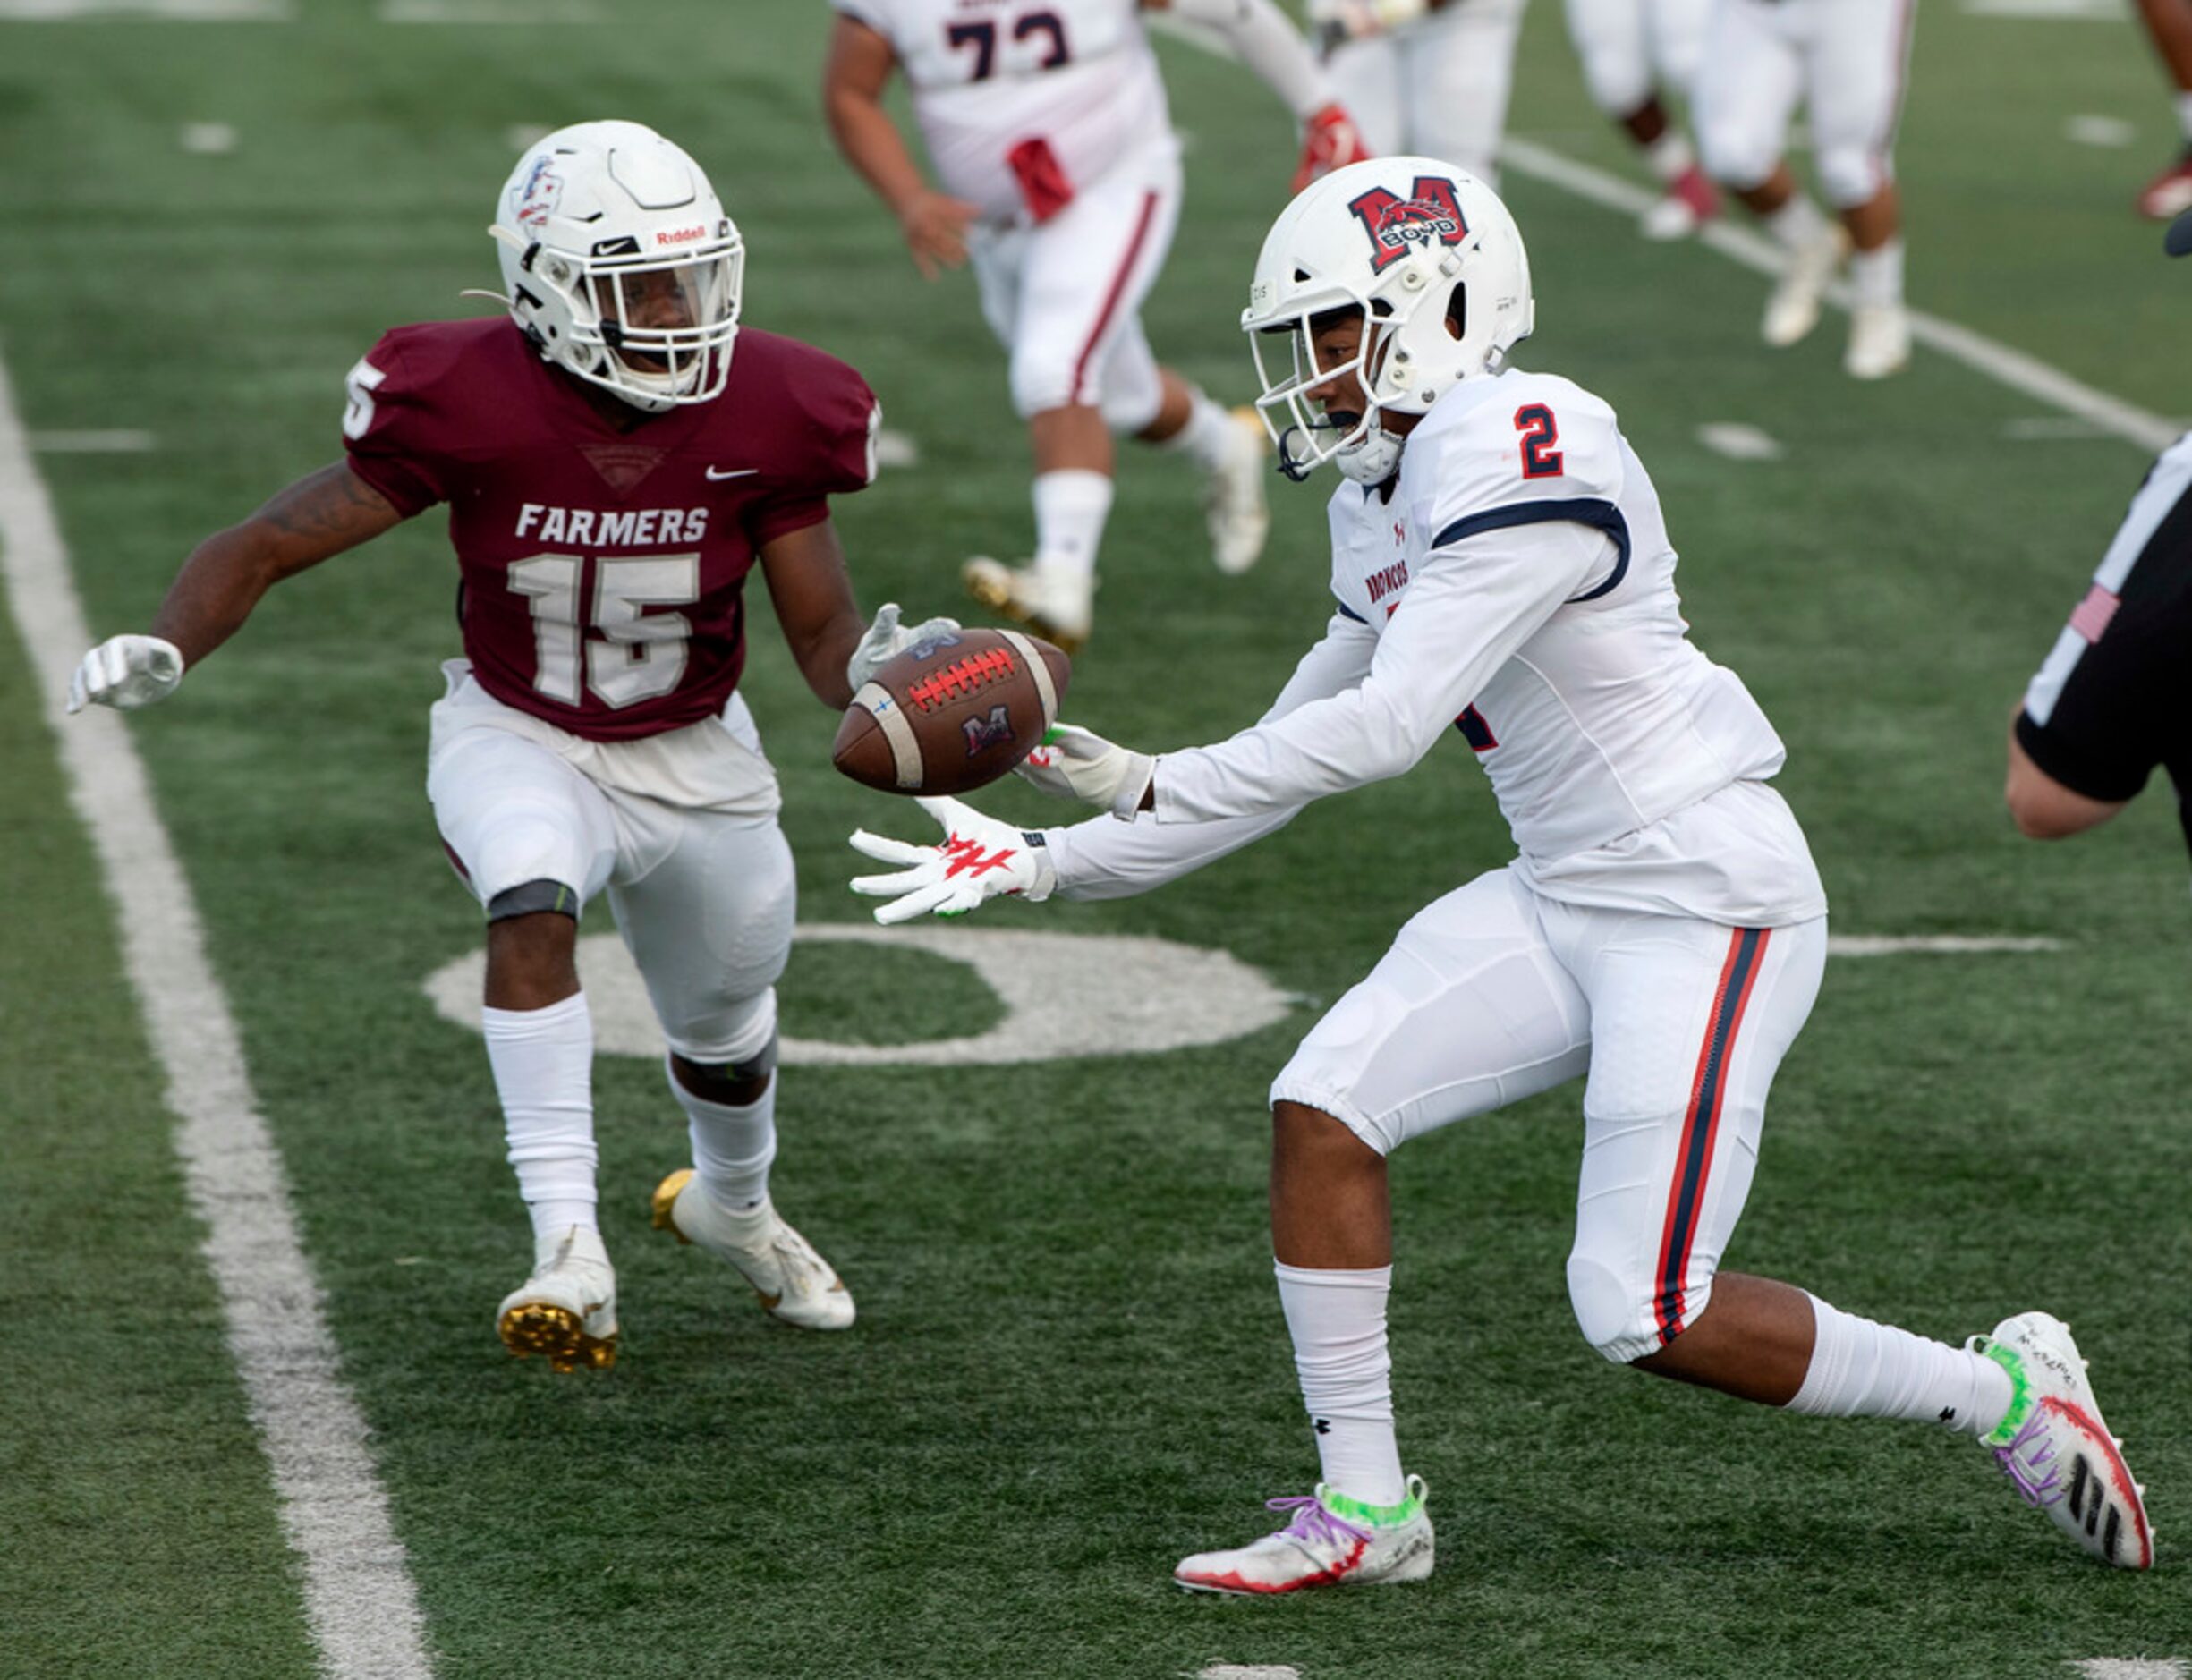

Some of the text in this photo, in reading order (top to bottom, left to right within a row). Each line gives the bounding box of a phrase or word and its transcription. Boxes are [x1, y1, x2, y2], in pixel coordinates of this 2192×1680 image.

[657, 225, 706, 245] Riddell
[1514, 403, 1564, 479] 2
[515, 503, 709, 547] FARMERS
[506, 552, 701, 711] 15
